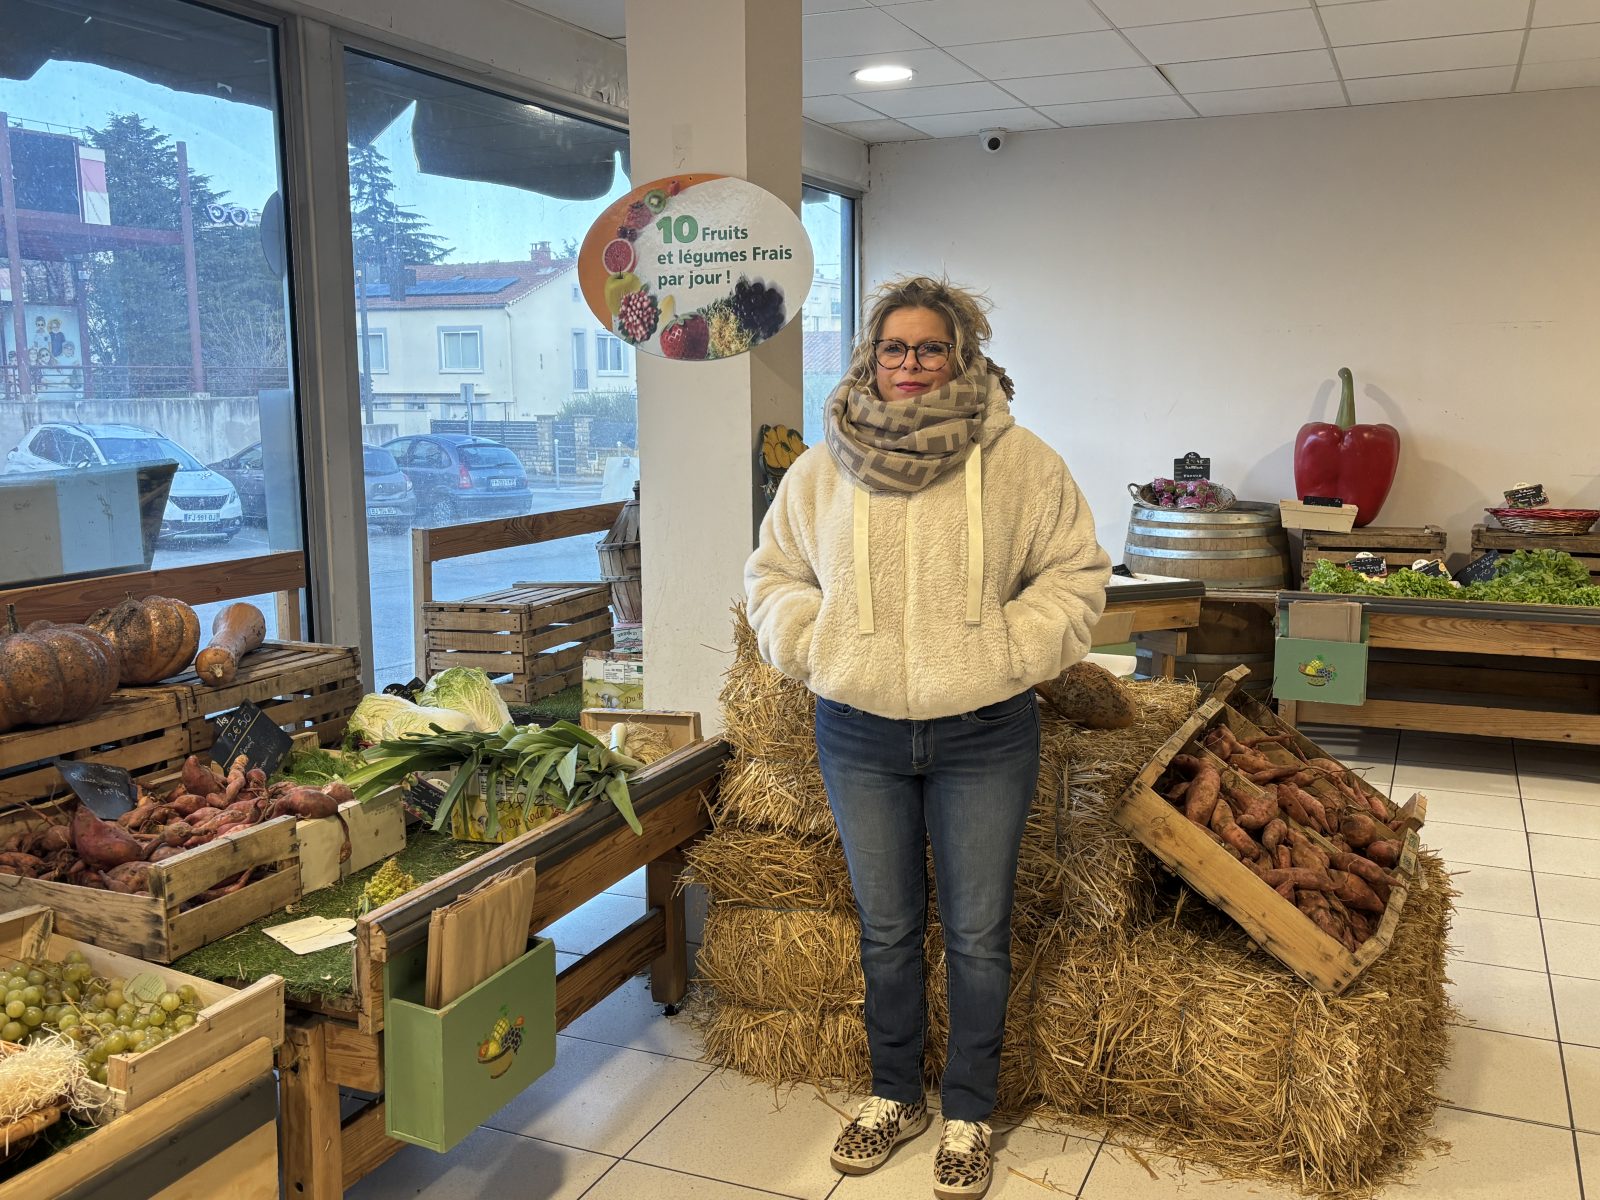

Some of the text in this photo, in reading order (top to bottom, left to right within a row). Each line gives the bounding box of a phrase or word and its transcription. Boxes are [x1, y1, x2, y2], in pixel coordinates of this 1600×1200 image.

[656, 214, 748, 244] 10 Fruits
[657, 245, 793, 268] et légumes Frais
[658, 270, 731, 290] par jour !
